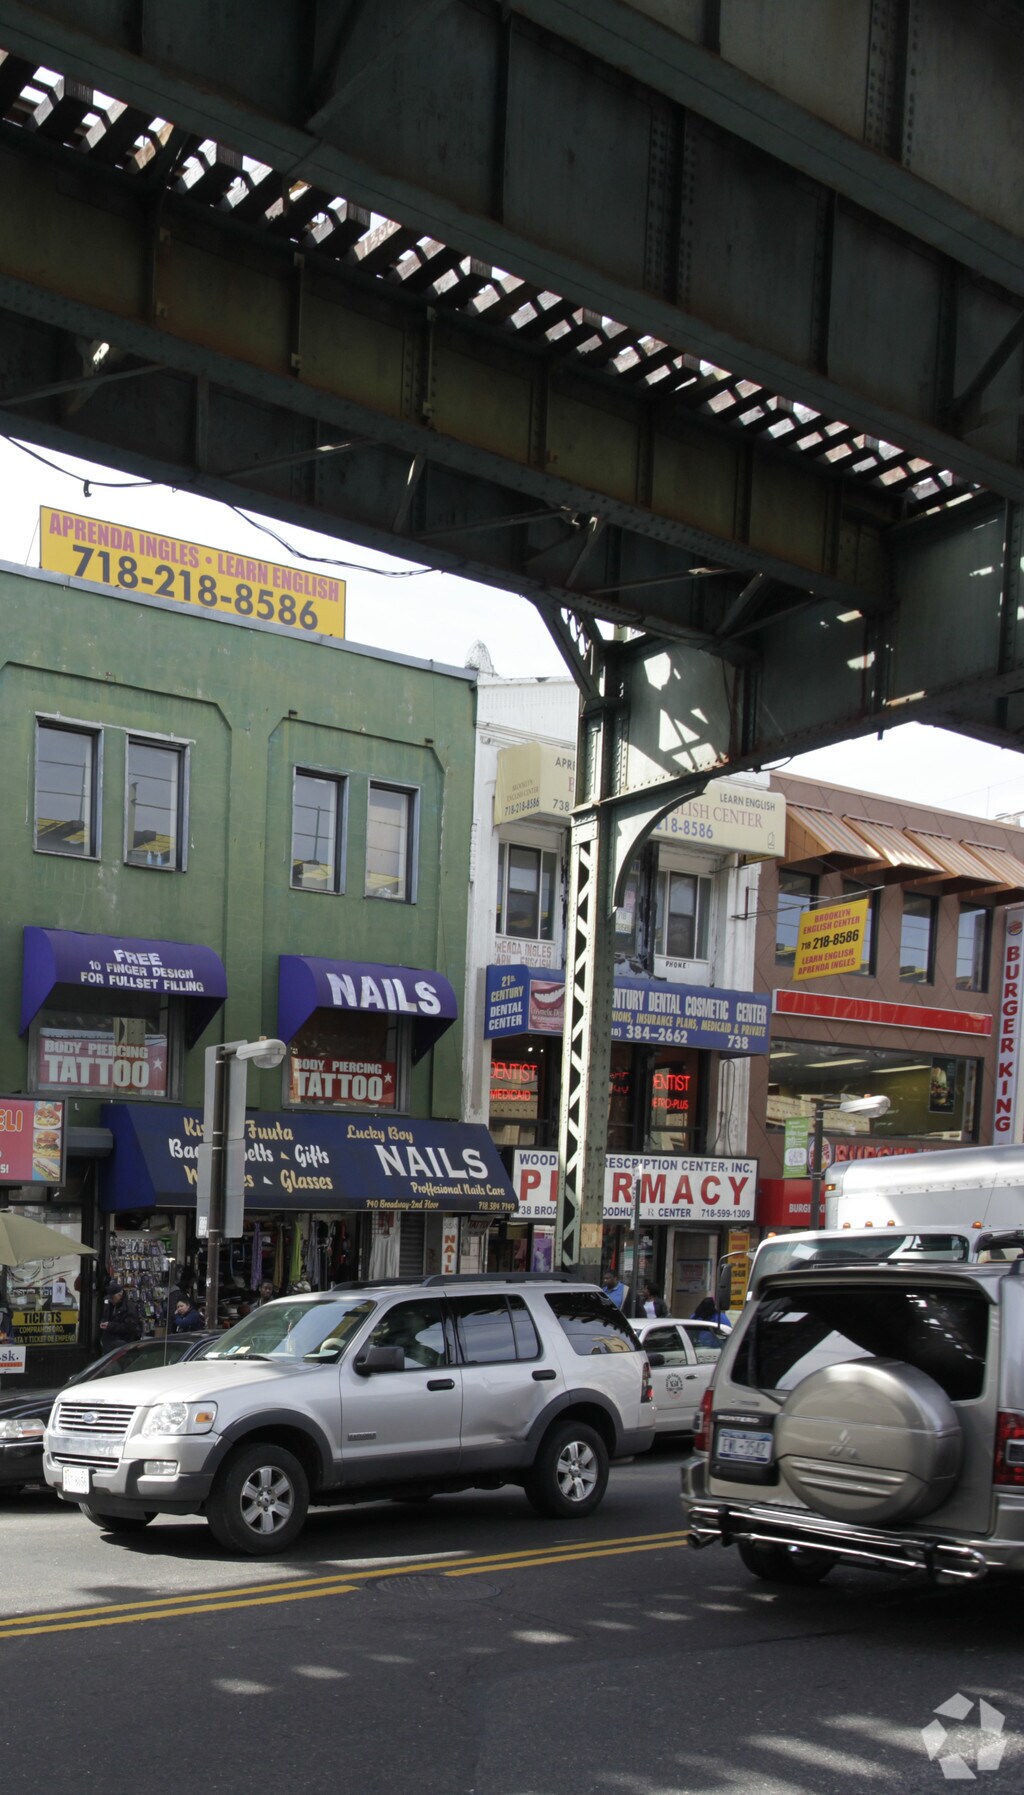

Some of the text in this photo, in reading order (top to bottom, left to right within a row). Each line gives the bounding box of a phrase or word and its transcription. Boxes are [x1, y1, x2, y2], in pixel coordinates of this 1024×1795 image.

[48, 511, 340, 602] APRENDA INGLES LEARN ENGLISH
[72, 545, 318, 630] 718-218-8586
[504, 796, 540, 816] 718-218-8586
[552, 798, 570, 812] 738
[719, 793, 776, 811] LEARN ENGLISH
[712, 808, 763, 829] CENTER
[814, 908, 852, 923] BROOKLYN
[803, 916, 860, 935] ENGLISH CENTER
[801, 929, 860, 951] 718 218-8586
[113, 949, 163, 966] FREE
[802, 948, 854, 965] LEARN ENGLISH
[88, 960, 194, 979] 10 FINGER DESIGN
[798, 958, 856, 976] APRENDA INGLES
[80, 971, 205, 992] FOR FULLSET FILLING
[326, 973, 442, 1015] NAILS
[490, 985, 524, 1002] CENTURY
[490, 1001, 523, 1017] DENTAL
[648, 992, 767, 1025] DENTAL COSMETIC CENTER
[488, 1014, 522, 1031] CENTER
[636, 1013, 674, 1027] INSURANCE
[676, 1017, 698, 1032] PLANS,
[701, 1020, 732, 1033] MEDICAID
[733, 1024, 739, 1035] &
[741, 1024, 766, 1037] PRIVATE
[626, 1025, 749, 1050] 384-2662 738
[994, 945, 1021, 1133] BURGER KING
[44, 1039, 149, 1059] BODY PIERCING
[44, 1054, 150, 1088] TATTOO
[297, 1058, 382, 1075] BODY PIERCING
[490, 1061, 538, 1082] DENTIST
[298, 1071, 383, 1101] TATTOO
[652, 1074, 691, 1092] ENTIST
[490, 1089, 531, 1102] MEDICAID
[346, 1124, 414, 1144] Lucky Boy
[244, 1142, 330, 1169] elts Gifts
[374, 1144, 489, 1180] NAILS
[731, 1162, 753, 1174] INC.
[280, 1169, 334, 1194] Glasses
[410, 1181, 506, 1196] Proffesional Nails Care
[366, 1200, 379, 1209] 740
[658, 1207, 751, 1218] CENTER 718-599-1309
[23, 1312, 62, 1324] TICKETS
[717, 1415, 759, 1424] MONTERO
